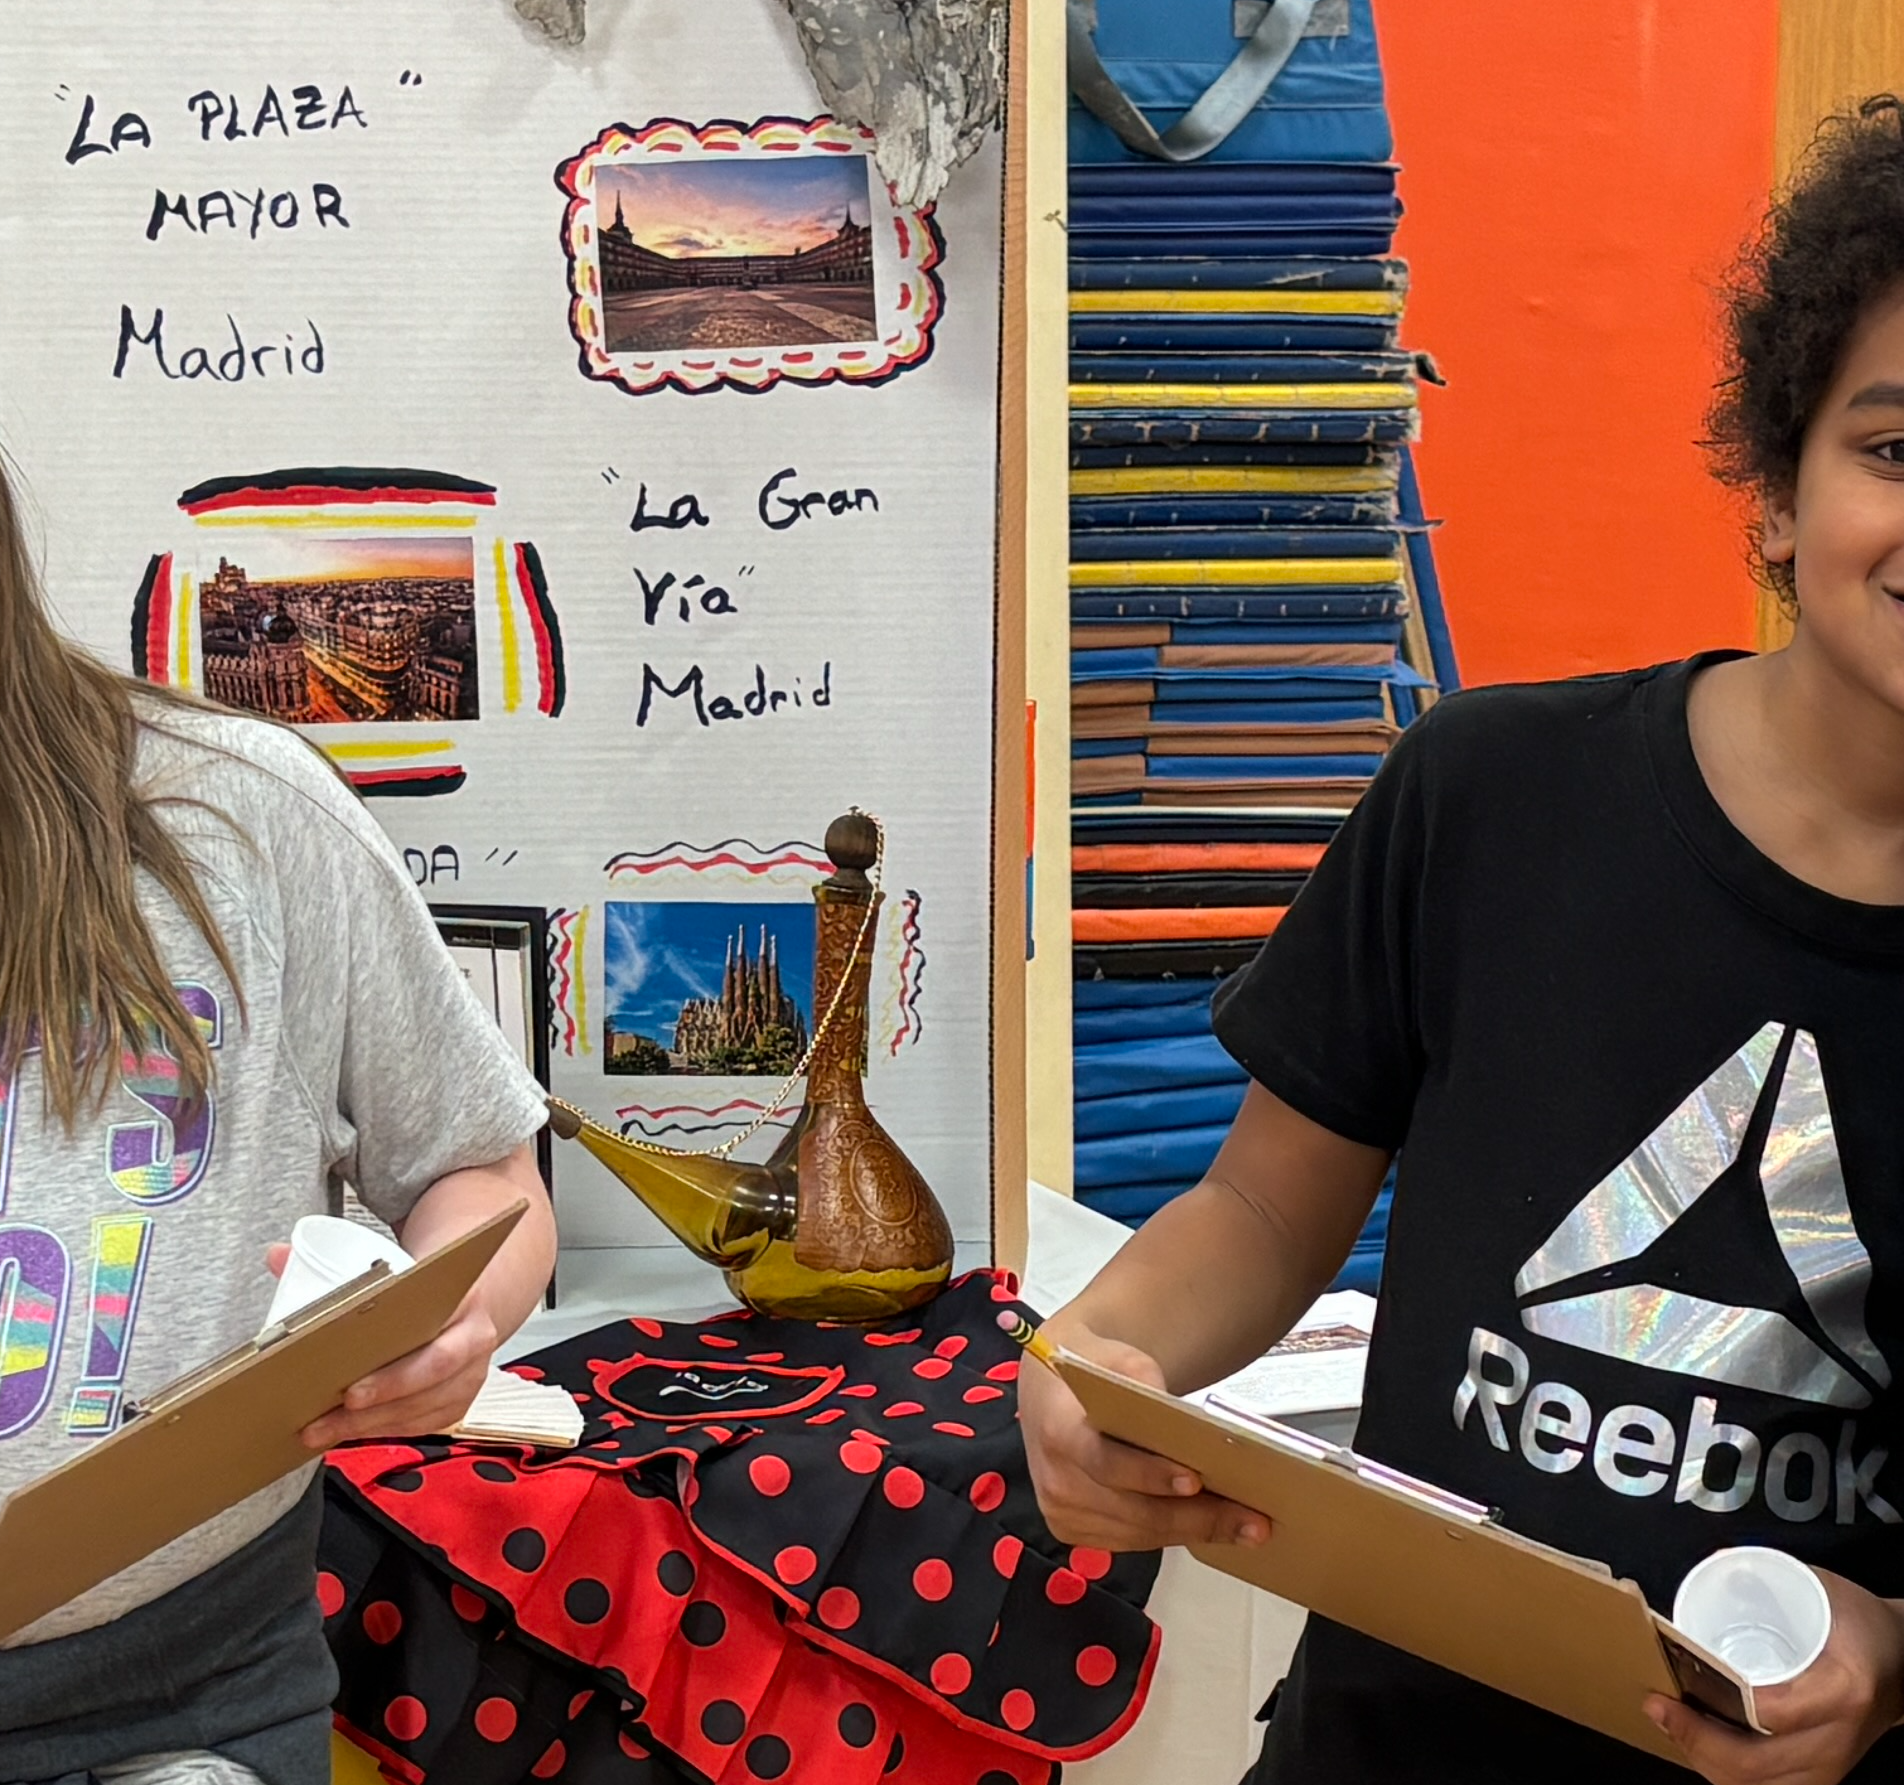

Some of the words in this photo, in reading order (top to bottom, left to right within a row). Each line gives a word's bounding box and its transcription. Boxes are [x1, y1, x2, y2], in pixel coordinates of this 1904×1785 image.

[145, 183, 351, 242] MAYOR
[112, 303, 327, 384] Madrid
[758, 467, 882, 532] Gran
[634, 660, 833, 729] Madrid
[1452, 1326, 1904, 1525] Reebok
